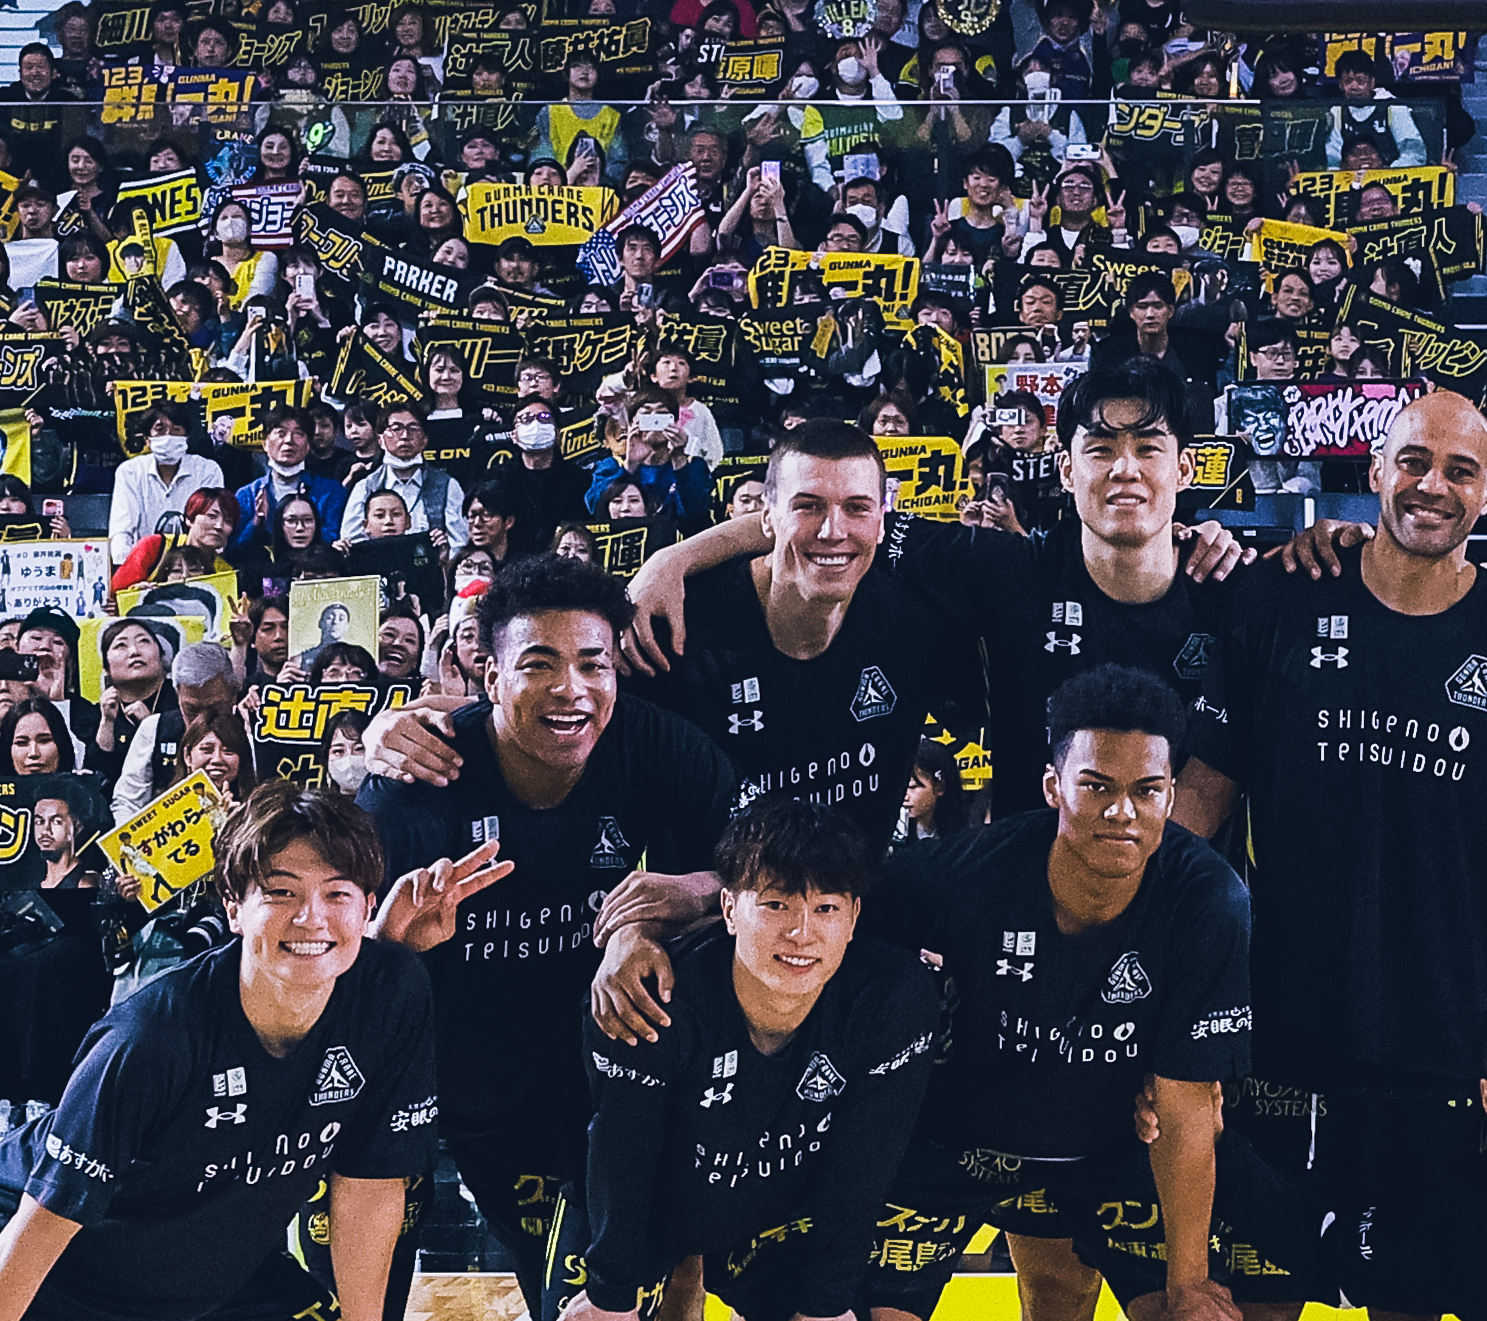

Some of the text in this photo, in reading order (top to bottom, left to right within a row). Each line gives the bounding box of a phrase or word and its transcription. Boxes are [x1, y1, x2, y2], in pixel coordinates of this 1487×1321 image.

[485, 184, 531, 203] GUNMA
[477, 198, 594, 231] THUNDERS
[829, 260, 871, 271] GUNMA
[383, 256, 457, 303] PARKER
[1016, 374, 1063, 394] 野本
[881, 445, 928, 459] GUNMA
[21, 566, 56, 578] ゆうま
